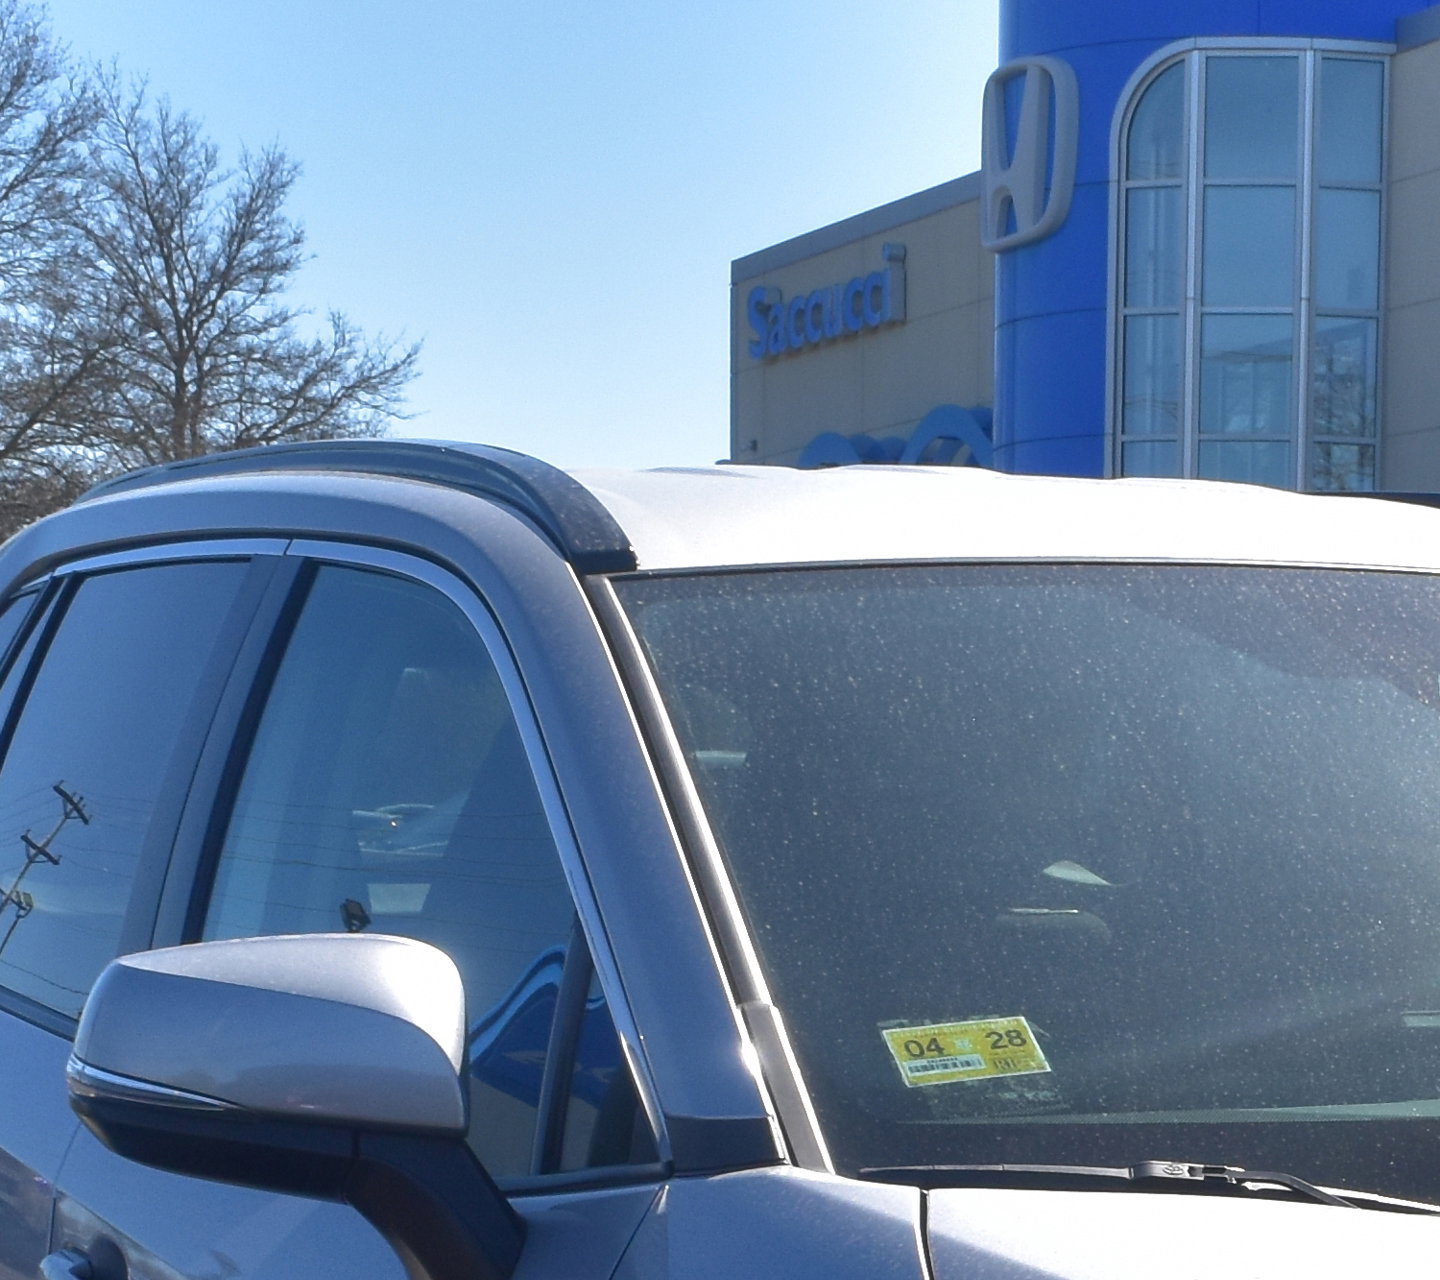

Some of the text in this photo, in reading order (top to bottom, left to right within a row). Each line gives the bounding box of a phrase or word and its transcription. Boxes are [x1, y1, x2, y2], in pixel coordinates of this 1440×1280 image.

[747, 243, 906, 359] Saccucci
[903, 1029, 1027, 1058] 04 28
